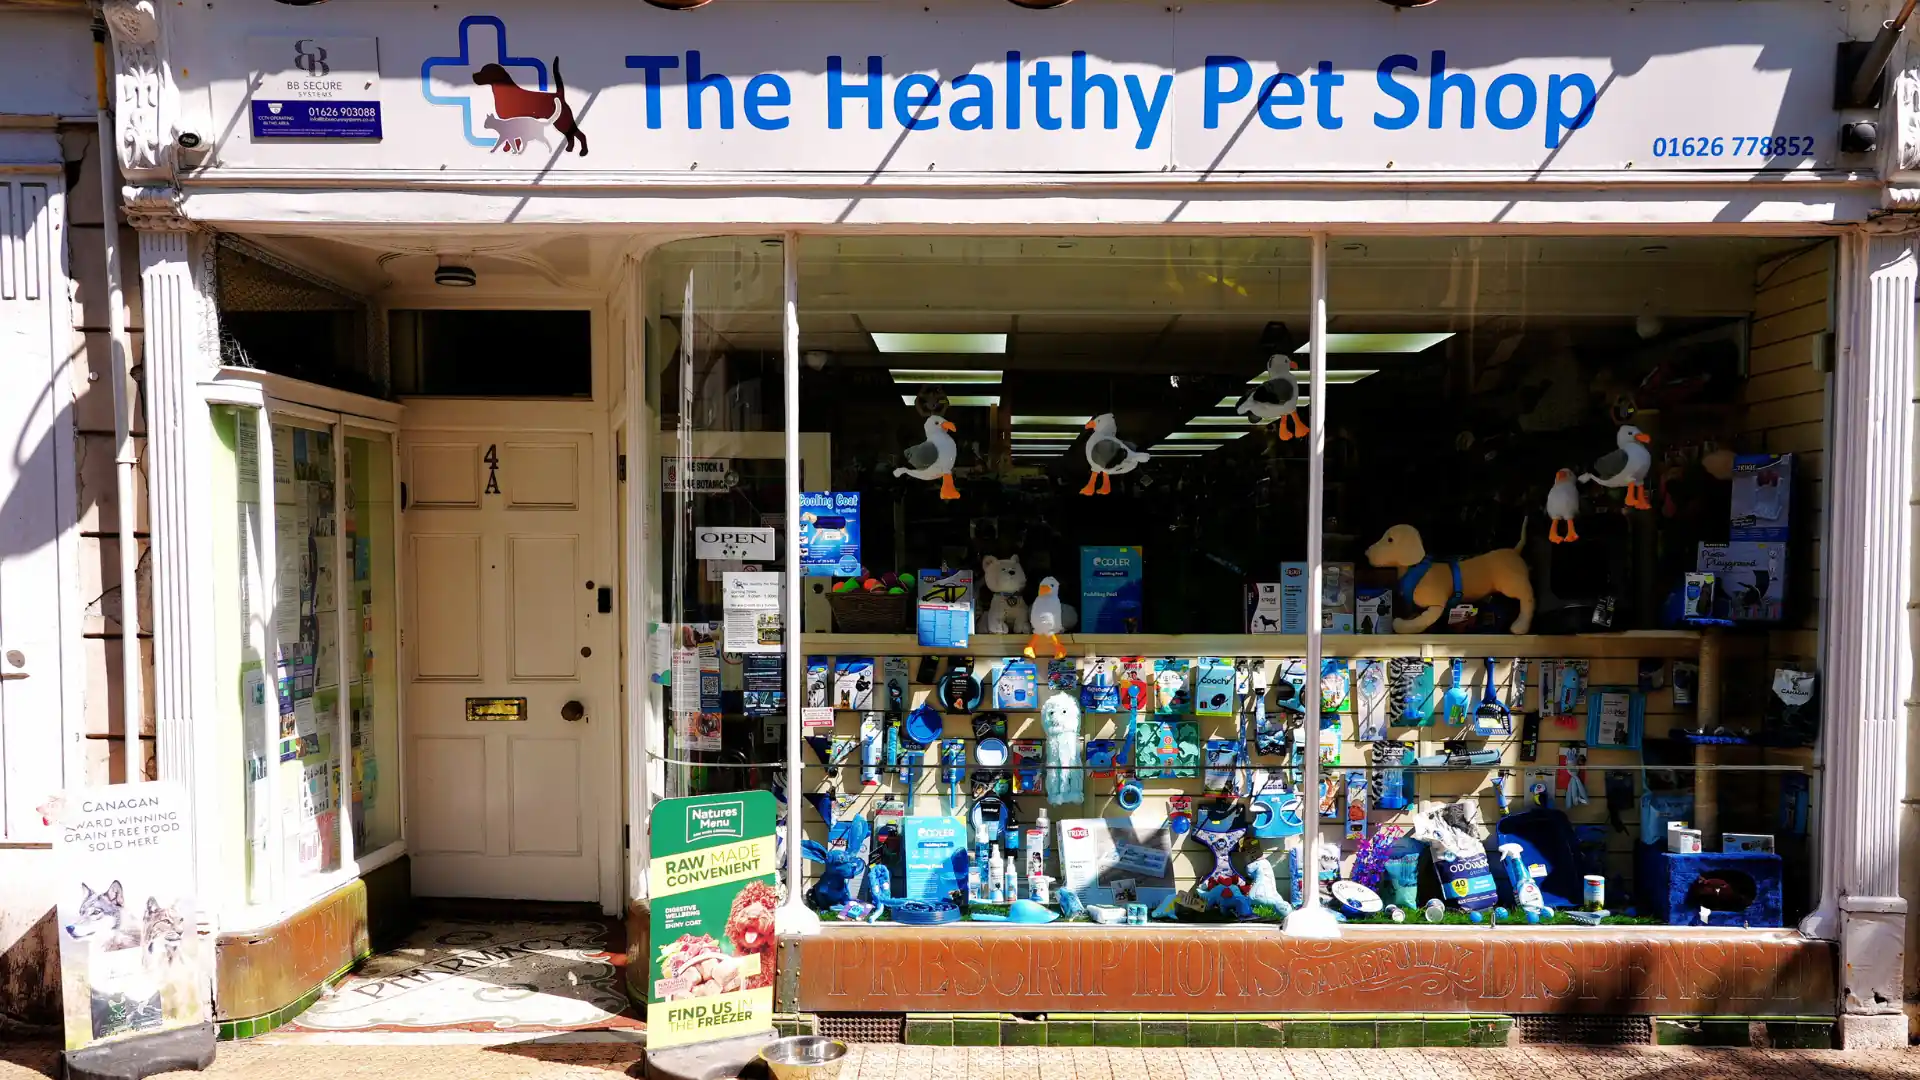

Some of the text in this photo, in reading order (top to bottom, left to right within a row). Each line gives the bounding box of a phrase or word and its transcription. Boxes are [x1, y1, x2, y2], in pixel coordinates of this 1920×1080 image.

[287, 81, 343, 90] BB SECURE
[625, 50, 1596, 150] The Healthy Pet Shop
[308, 107, 376, 117] 01626 903088
[1653, 136, 1816, 157] 01626 778852
[483, 444, 499, 470] 4
[696, 462, 718, 473] STOCK
[484, 469, 501, 494] A
[799, 493, 859, 509] Cooling Coat
[700, 532, 769, 544] OPEN
[1200, 676, 1231, 686] Coachi
[82, 797, 159, 813] CANAGAN
[117, 811, 177, 825] WINNING
[692, 807, 738, 820] Natures
[700, 818, 730, 829] Menu
[64, 823, 180, 843] GRAIN FREE FOOD
[88, 836, 159, 852] SOLD HERE
[665, 843, 761, 875] RAW MADE
[666, 858, 761, 887] CONVENIENT
[1455, 879, 1466, 888] 40
[665, 919, 702, 930] SHINY COAT
[828, 935, 1813, 1000] PRESCRIPTIONS CAREFULLY DISPENSED
[668, 997, 753, 1022] FIND US IN
[668, 1011, 753, 1033] THE FREEZER
